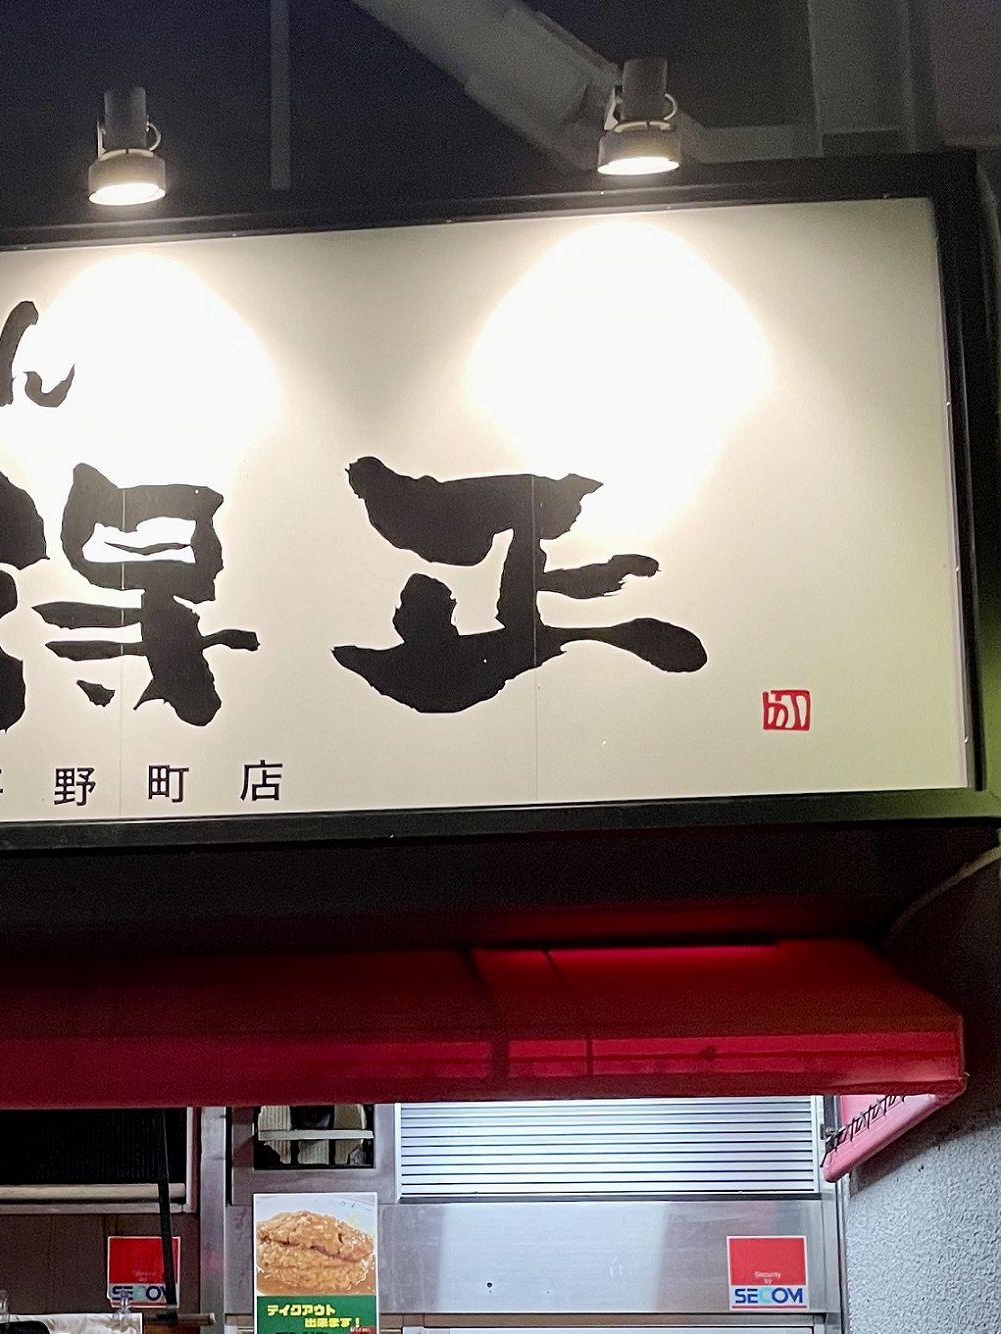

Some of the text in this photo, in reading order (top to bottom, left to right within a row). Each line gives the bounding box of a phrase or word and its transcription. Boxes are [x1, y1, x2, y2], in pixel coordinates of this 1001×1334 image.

[734, 1288, 803, 1304] SECOM
[267, 1304, 336, 1316] テイクアウト
